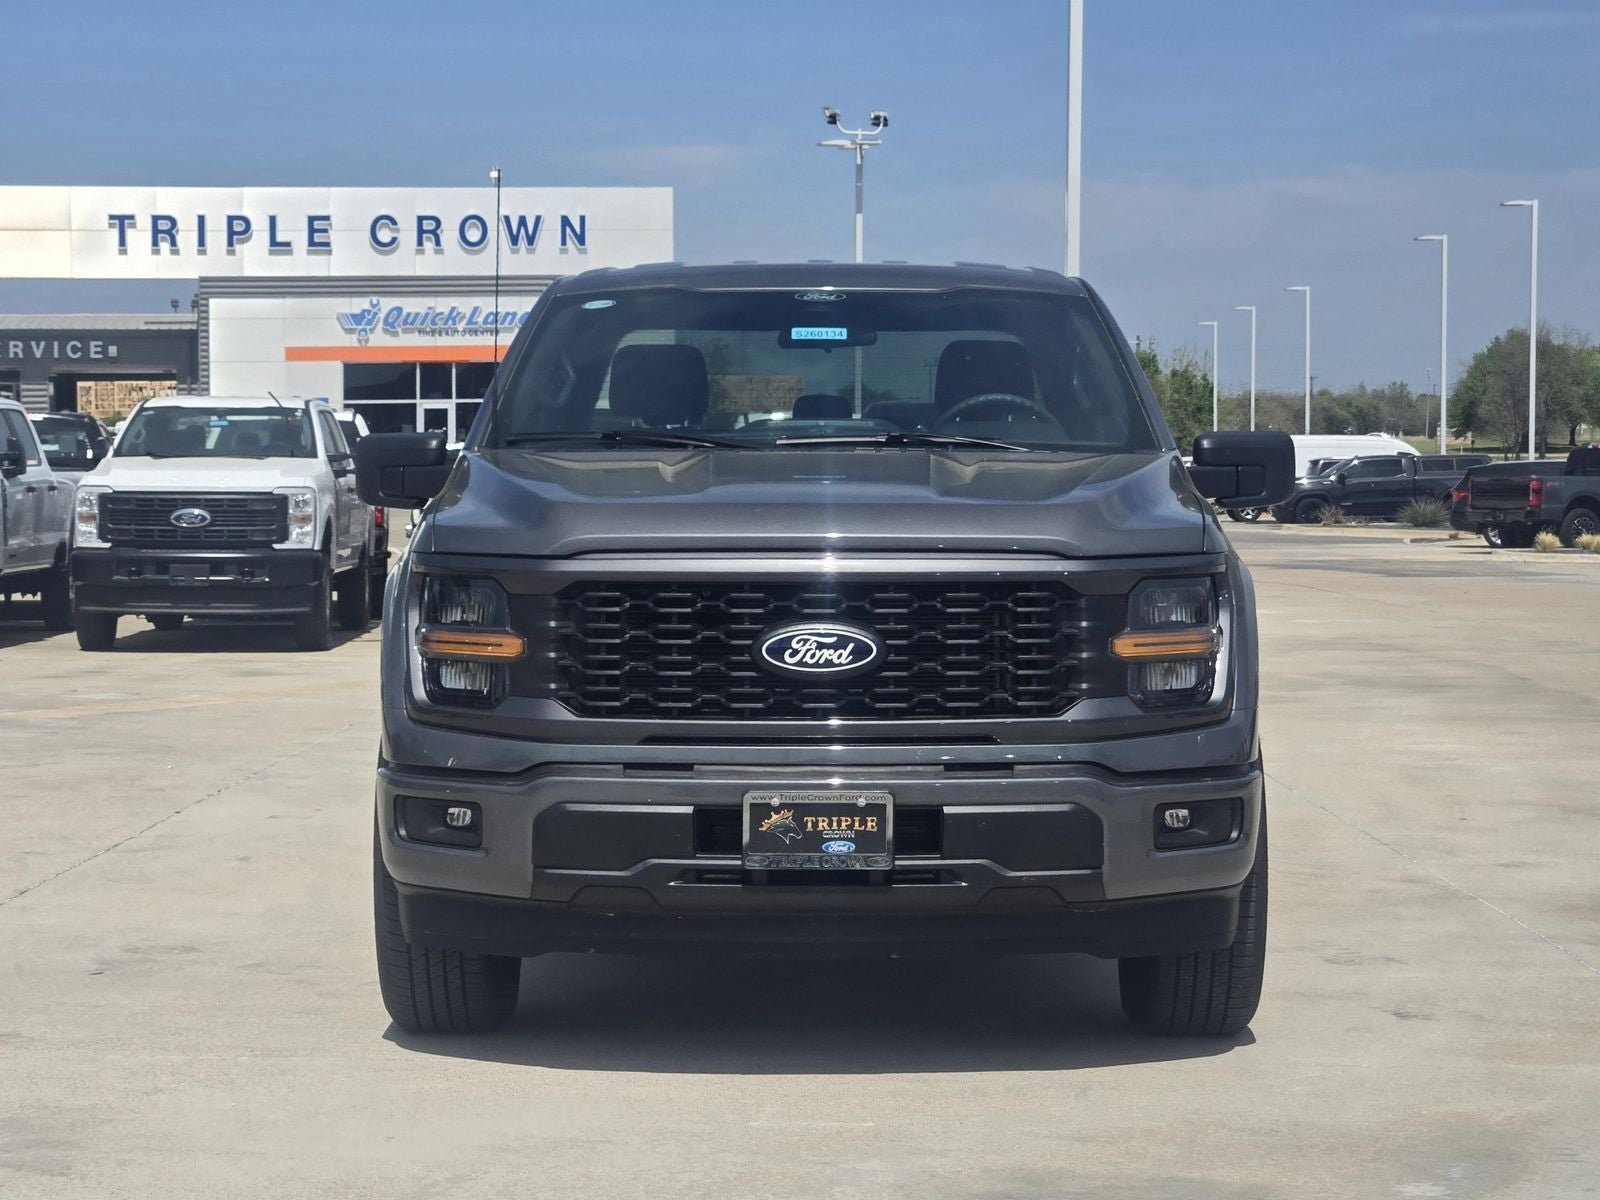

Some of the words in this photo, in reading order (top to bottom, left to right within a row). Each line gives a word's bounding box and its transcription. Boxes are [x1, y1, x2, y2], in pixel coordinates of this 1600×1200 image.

[107, 214, 332, 249] TRIPLE
[368, 214, 588, 249] CROWN
[382, 305, 464, 330] Quick
[445, 329, 466, 337] AUTO
[795, 330, 844, 338] S260134
[0, 340, 104, 359] RVICE
[783, 634, 855, 664] Ford
[803, 816, 878, 832] TRIPLE
[822, 830, 855, 838] CROWN
[828, 841, 850, 851] Ford
[769, 855, 820, 868] TRIPLE
